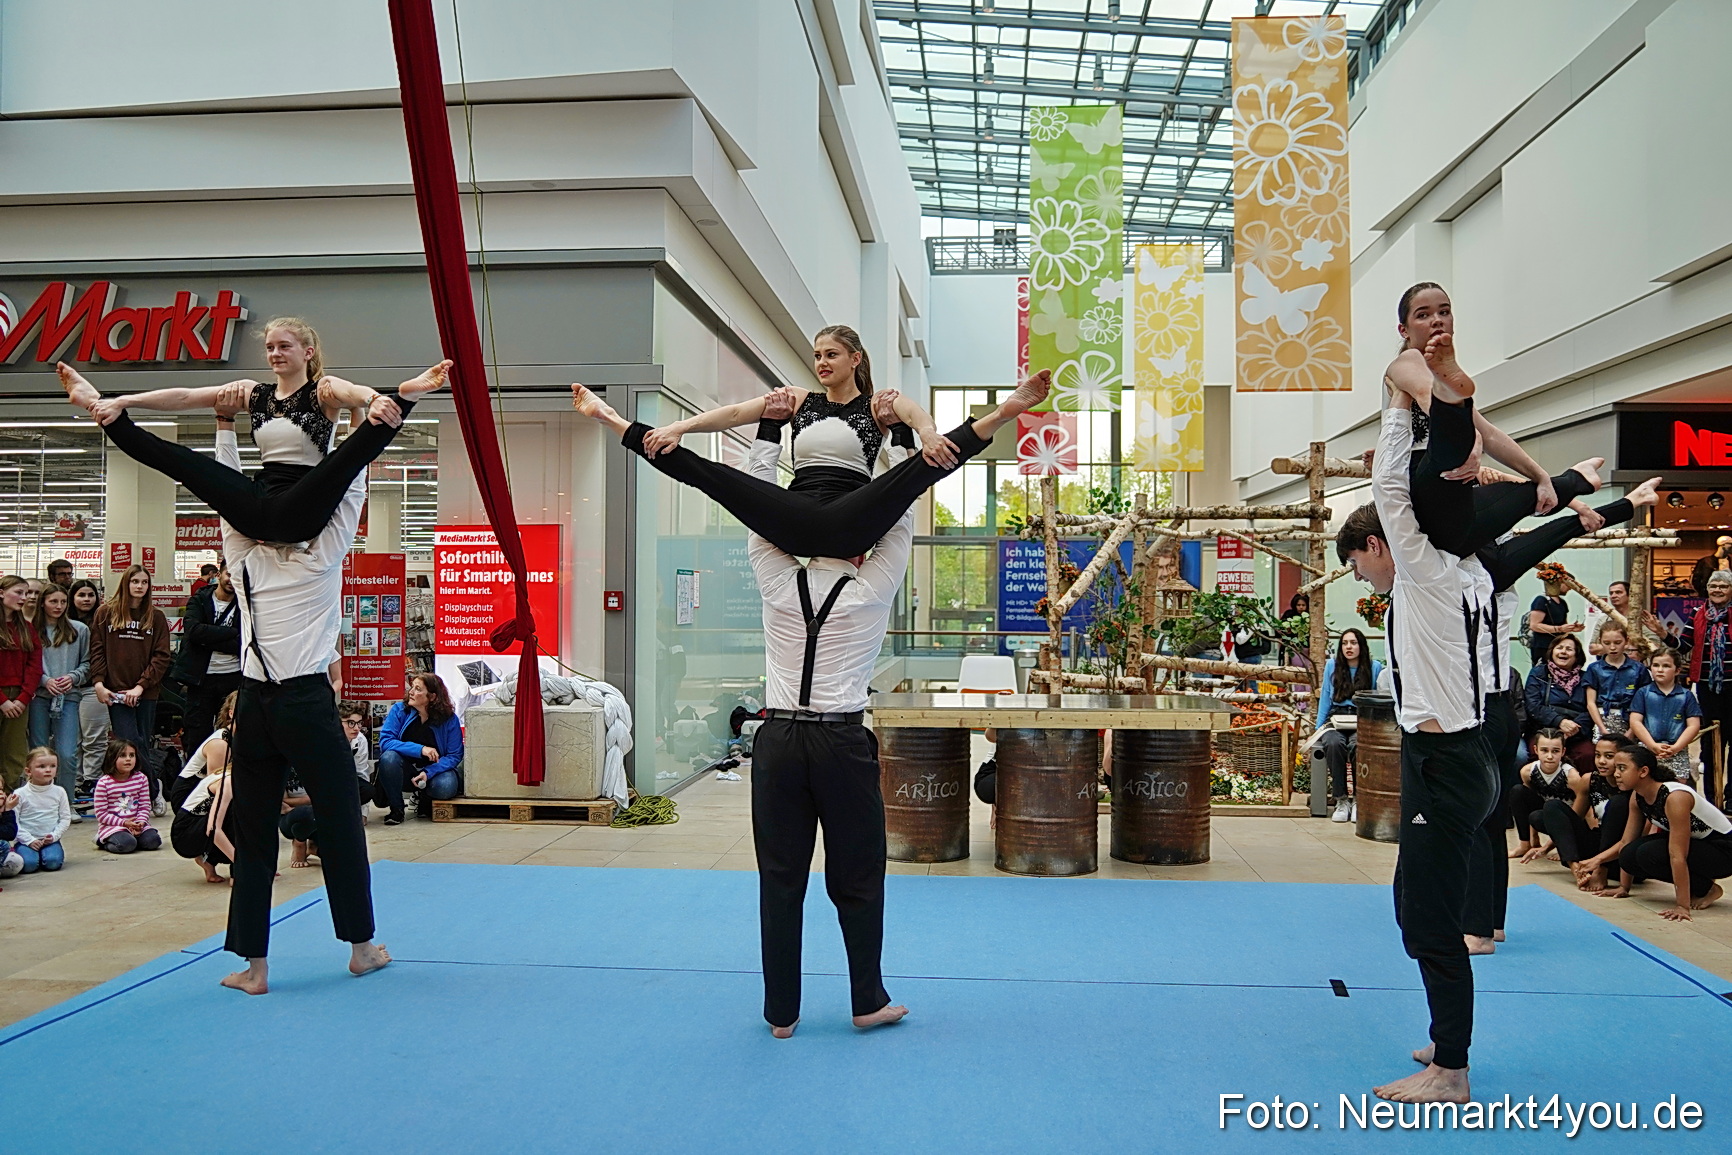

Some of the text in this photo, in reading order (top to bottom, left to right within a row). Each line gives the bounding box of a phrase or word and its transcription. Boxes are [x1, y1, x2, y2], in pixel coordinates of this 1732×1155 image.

[0, 281, 244, 363] Markt
[175, 524, 220, 538] artbar
[487, 534, 497, 542] Se
[1005, 547, 1022, 557] Ich
[439, 551, 509, 564] Soforthilf
[1005, 559, 1026, 569] den
[344, 575, 400, 585] Vorbesteller
[439, 569, 554, 585] für Smartpnes
[1005, 571, 1047, 581] Fernseh
[1218, 573, 1240, 583] REWE
[439, 587, 492, 595] hier im Markt.
[1005, 583, 1047, 592] der Wel
[444, 603, 494, 612] Displayschutz
[444, 615, 494, 624] Displaytausch
[444, 627, 486, 635] Akkutausch
[445, 639, 459, 647] und
[460, 639, 480, 647] vieles
